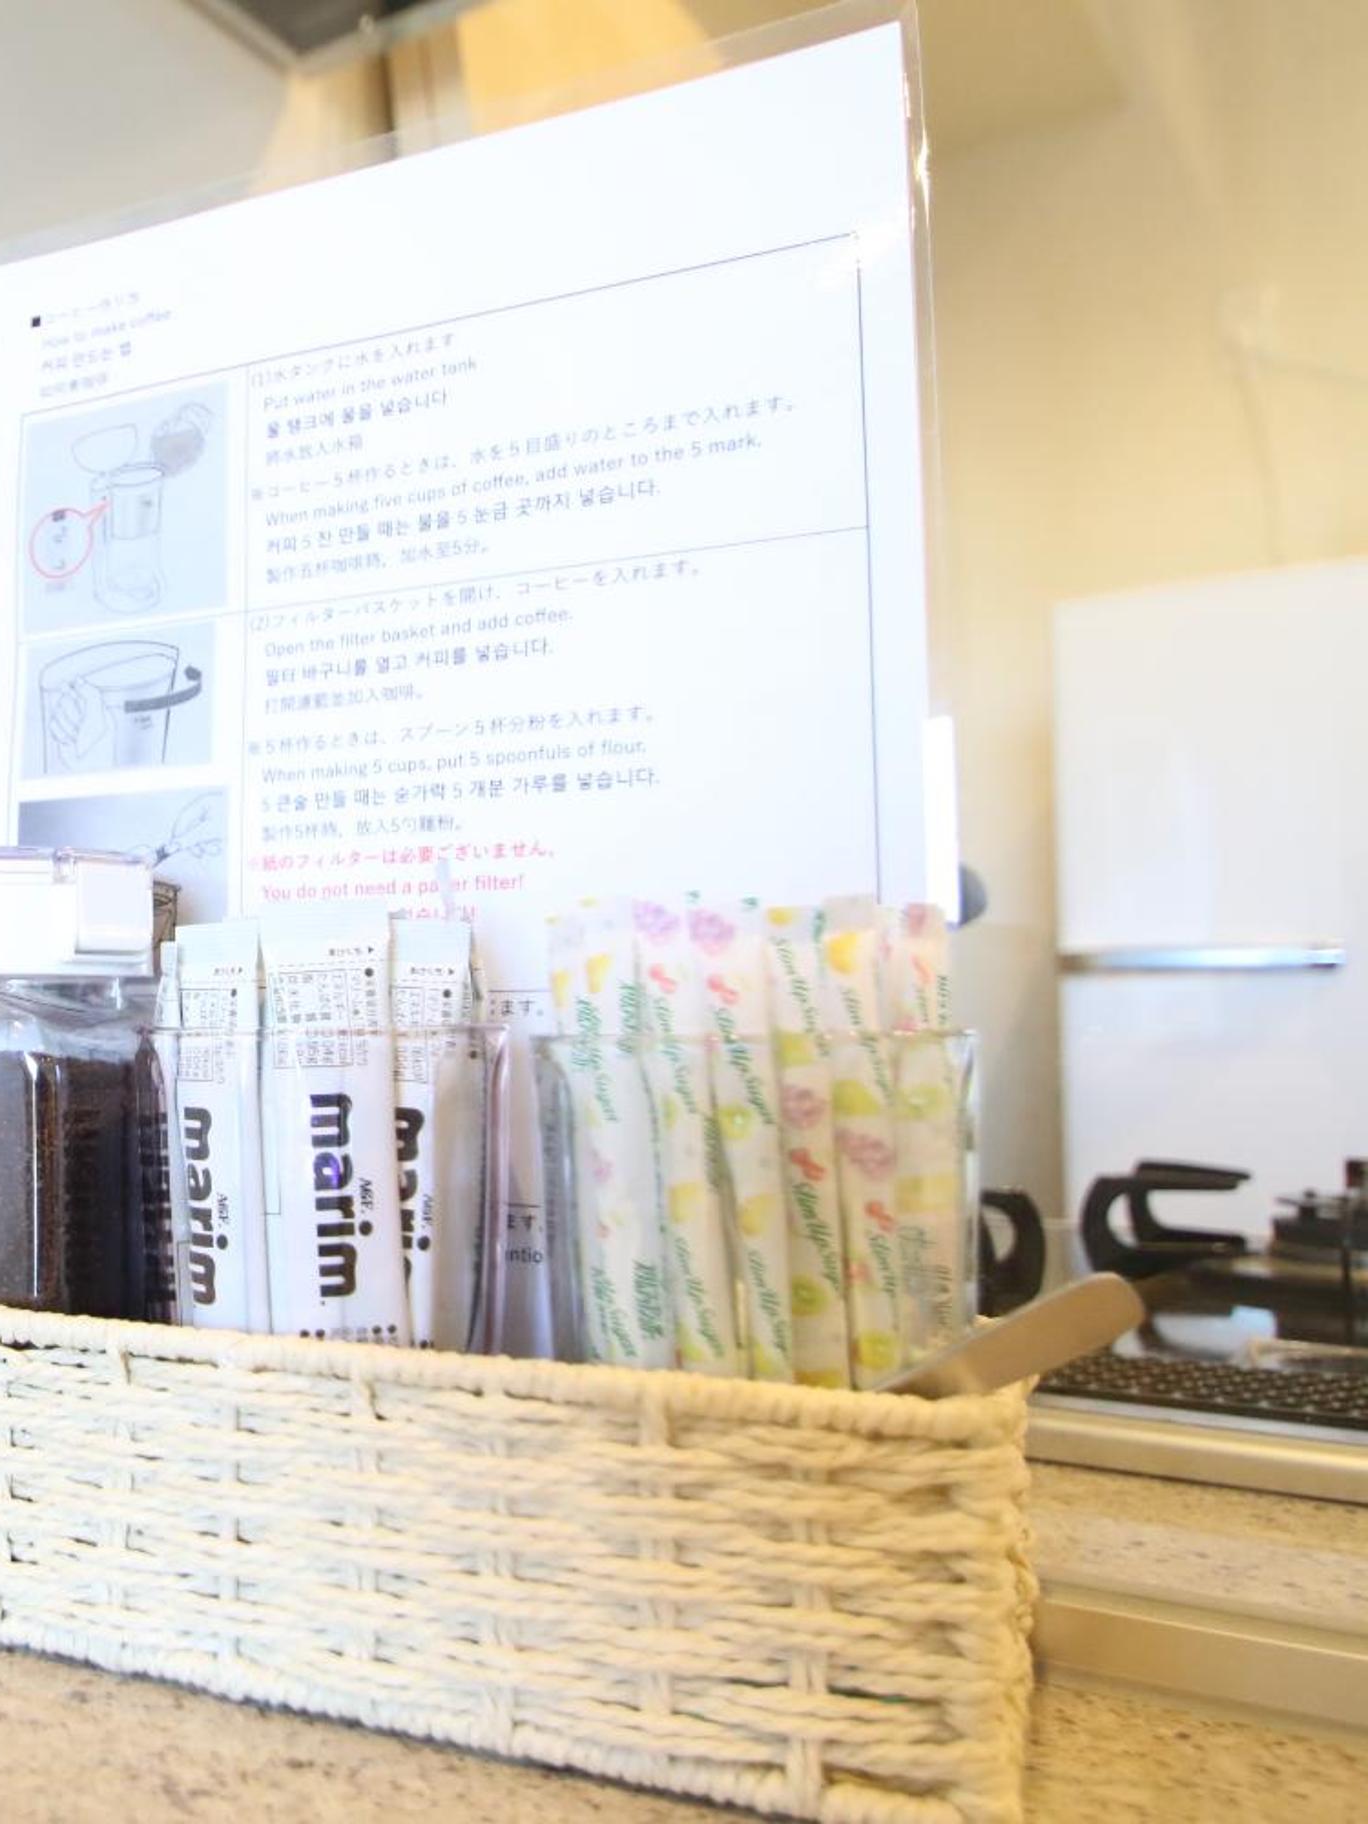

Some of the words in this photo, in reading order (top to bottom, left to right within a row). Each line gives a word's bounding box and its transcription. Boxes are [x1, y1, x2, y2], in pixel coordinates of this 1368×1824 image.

[263, 392, 289, 412] Put
[295, 386, 336, 406] water
[342, 381, 355, 396] in
[360, 373, 386, 391] the
[391, 365, 435, 386] water
[441, 355, 477, 377] tank
[266, 509, 309, 528] When
[313, 499, 370, 521] making
[375, 493, 402, 510] five
[408, 482, 445, 505] cups
[452, 480, 467, 498] of
[535, 462, 568, 483] add
[573, 456, 624, 478] water
[631, 451, 648, 468] to
[655, 446, 685, 463] the
[691, 440, 702, 458] 5
[267, 535, 296, 556] 커피
[302, 535, 311, 550] 5
[457, 510, 468, 525] 5
[264, 639, 305, 657] Open
[310, 637, 334, 652] the
[340, 632, 377, 649] filter
[382, 622, 434, 644] basket
[440, 618, 472, 636] and
[477, 612, 508, 631] add
[515, 606, 573, 626] coffee.
[263, 767, 305, 785] When
[311, 758, 368, 780] making
[373, 759, 382, 774] 5
[437, 754, 463, 773] put
[470, 752, 481, 767] 5
[486, 743, 572, 767] spoonfuls
[577, 743, 594, 758] of
[453, 782, 463, 799] 5
[263, 884, 292, 901] You
[296, 882, 316, 899] do
[322, 881, 348, 898] not
[355, 877, 396, 897] need
[402, 882, 412, 896] a
[419, 878, 468, 899] paer
[184, 1106, 230, 1306] marim
[309, 1092, 373, 1298] marim
